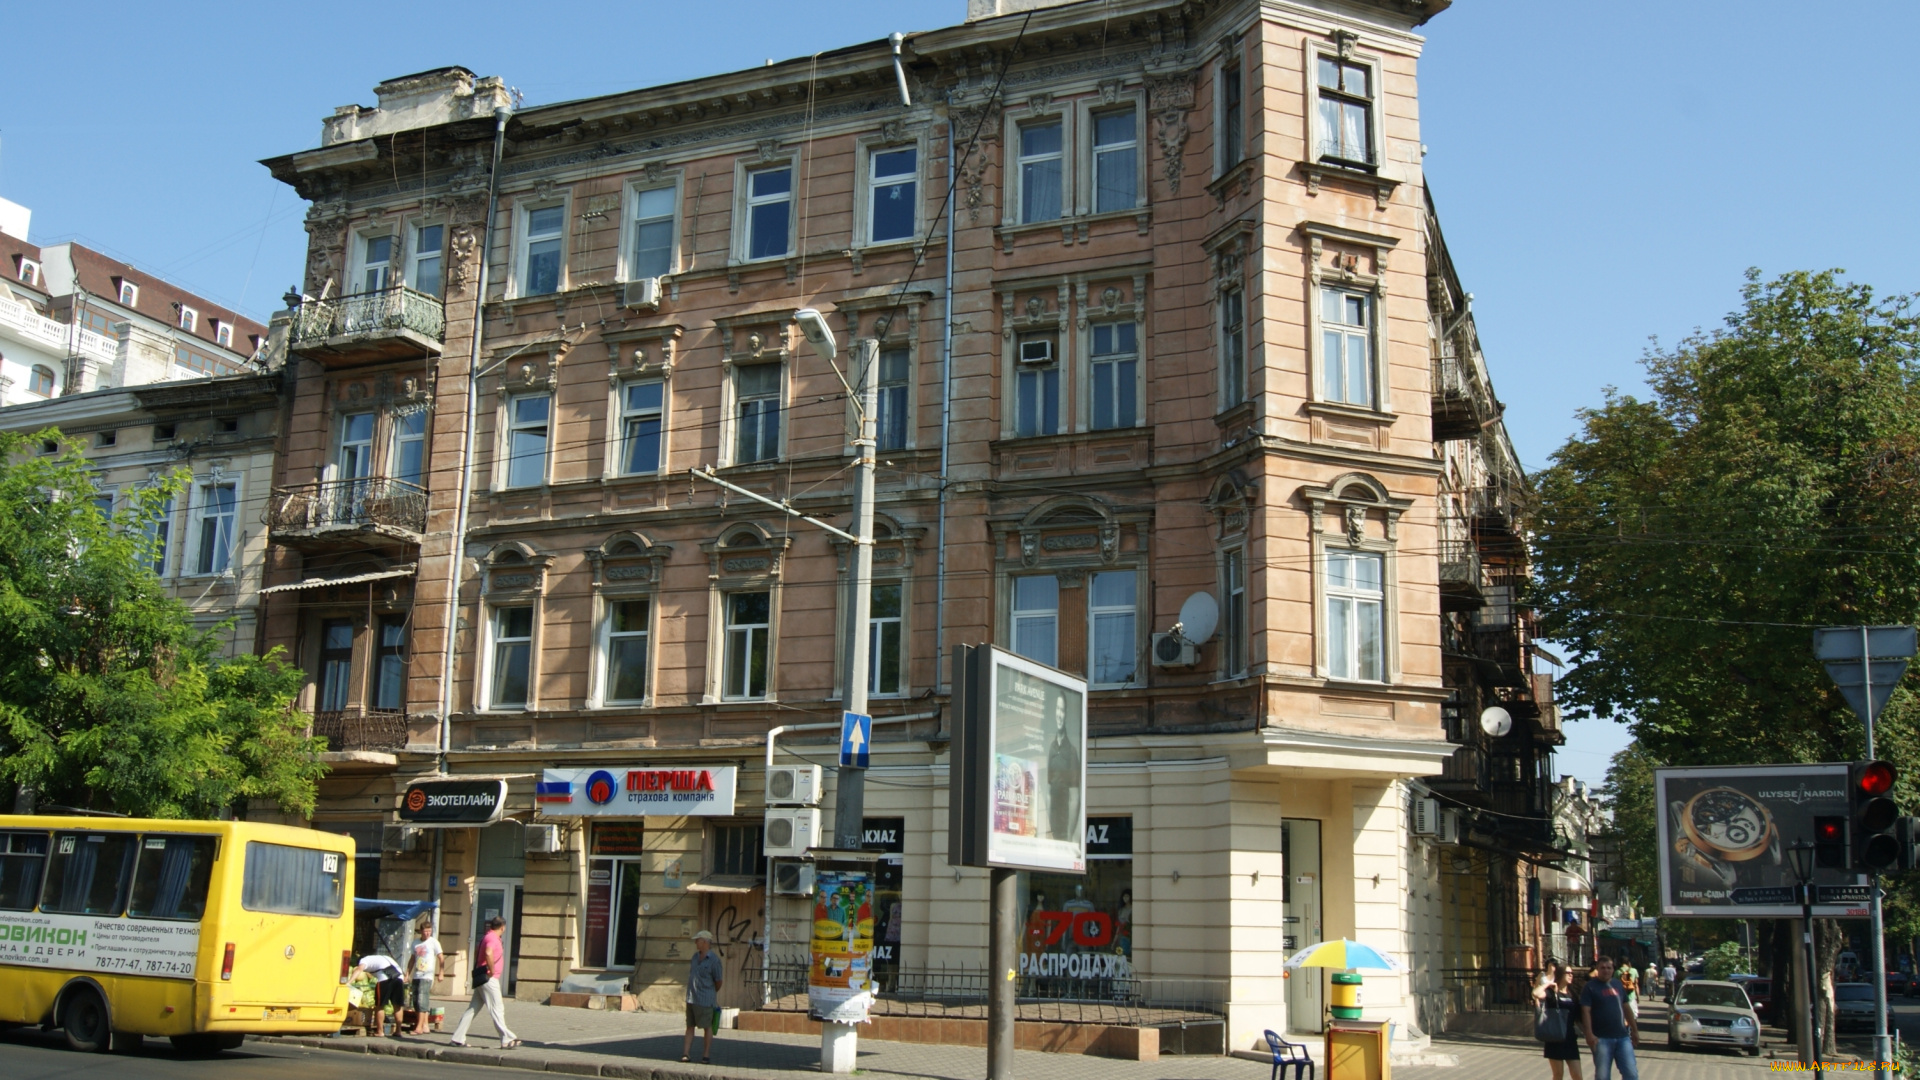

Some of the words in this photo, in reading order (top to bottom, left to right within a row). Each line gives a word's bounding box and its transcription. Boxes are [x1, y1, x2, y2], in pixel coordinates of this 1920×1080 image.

[626, 770, 714, 791] ПЕРША
[427, 792, 495, 806] ЭКОТЕПЛАЙН
[628, 791, 669, 804] страхова
[672, 791, 715, 802] компанія
[1758, 790, 1797, 798] ULYSSE
[1086, 825, 1109, 843] AZ
[325, 856, 337, 871] 127
[0, 915, 50, 925] nfo@novikon.com.ua
[94, 921, 125, 931] Качество
[126, 924, 173, 934] современных
[0, 924, 88, 946] ОВИКОН
[119, 935, 160, 943] производителя
[0, 944, 17, 952] НА
[35, 946, 86, 957] ДВЕРИ
[95, 943, 127, 952] Приглашаем
[133, 947, 176, 957] сотрудничеству
[95, 957, 142, 972] 787-77-47,
[146, 960, 192, 974] 787-74-20
[1019, 952, 1130, 979] РАСПРОДАЖА
